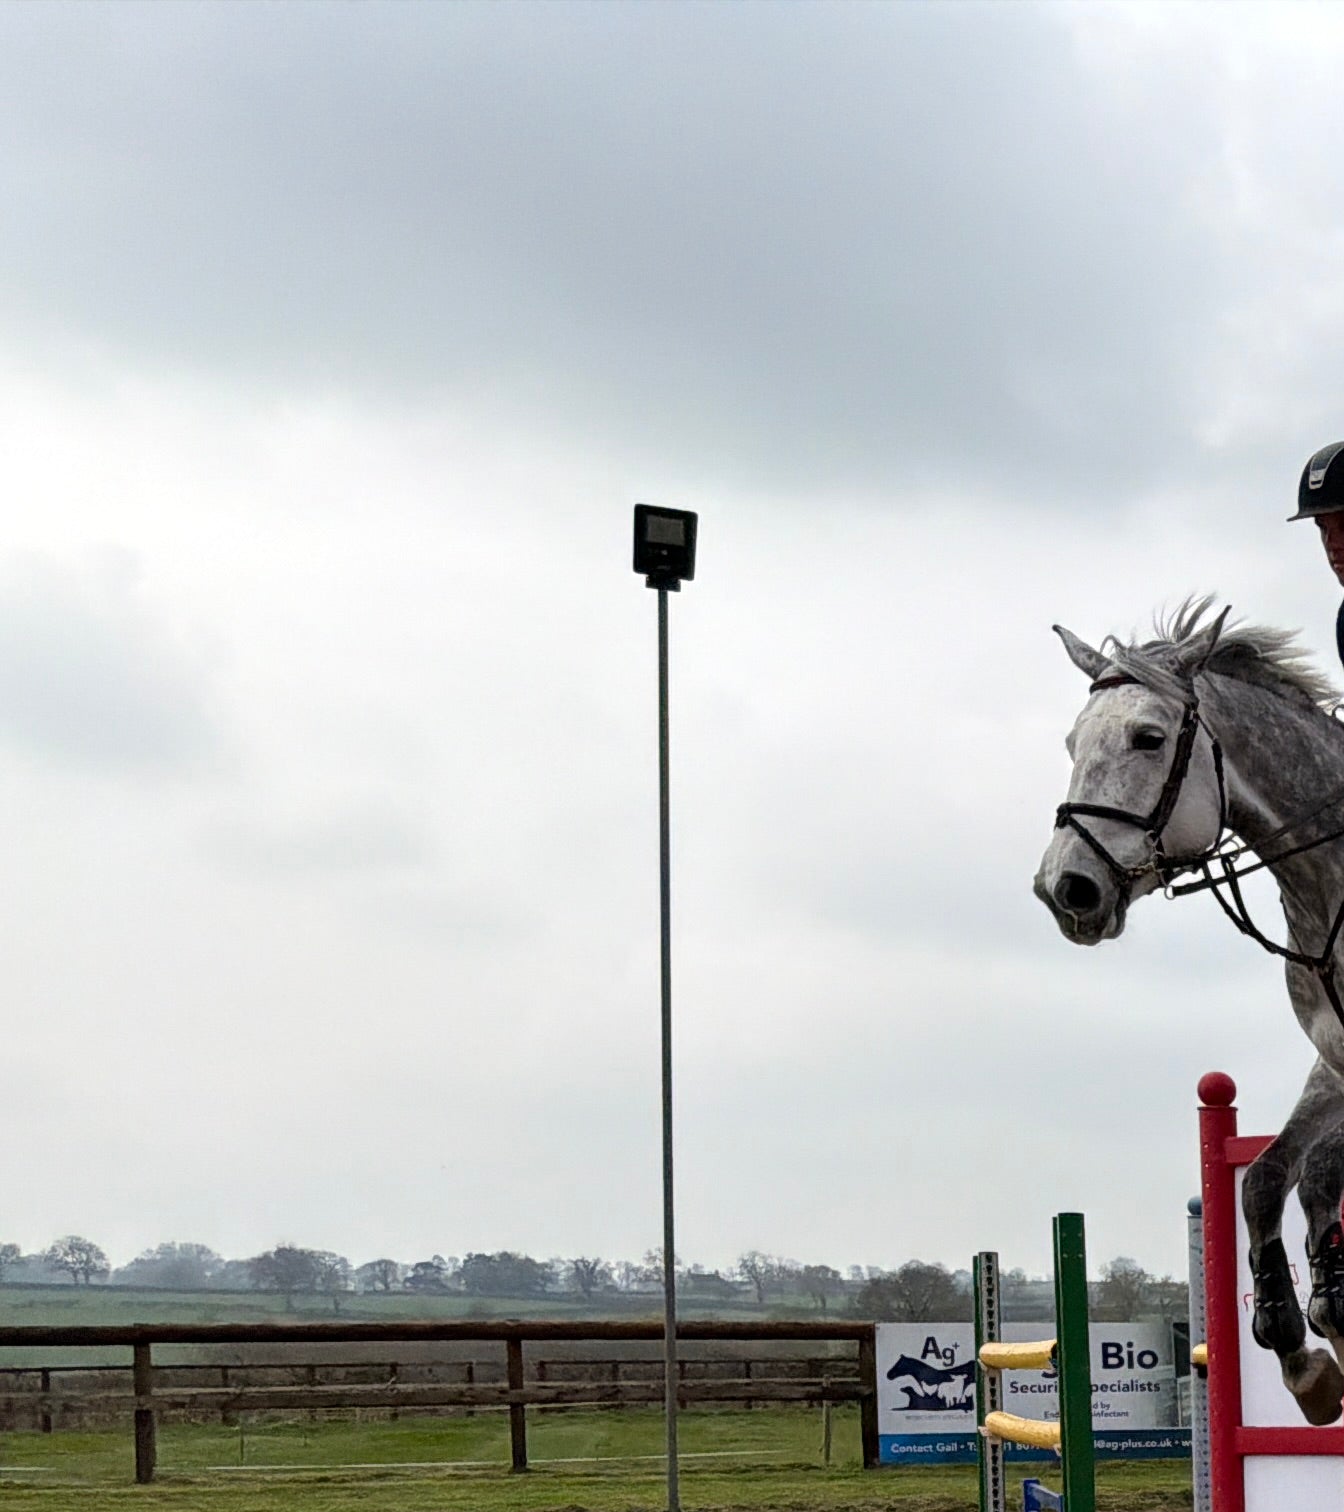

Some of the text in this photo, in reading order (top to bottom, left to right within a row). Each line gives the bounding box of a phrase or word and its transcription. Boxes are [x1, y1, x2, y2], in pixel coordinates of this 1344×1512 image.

[1101, 1341, 1159, 1369] Bio
[1009, 1380, 1058, 1394] Securi
[891, 1443, 933, 1453] Contact
[936, 1442, 957, 1453] Gail
